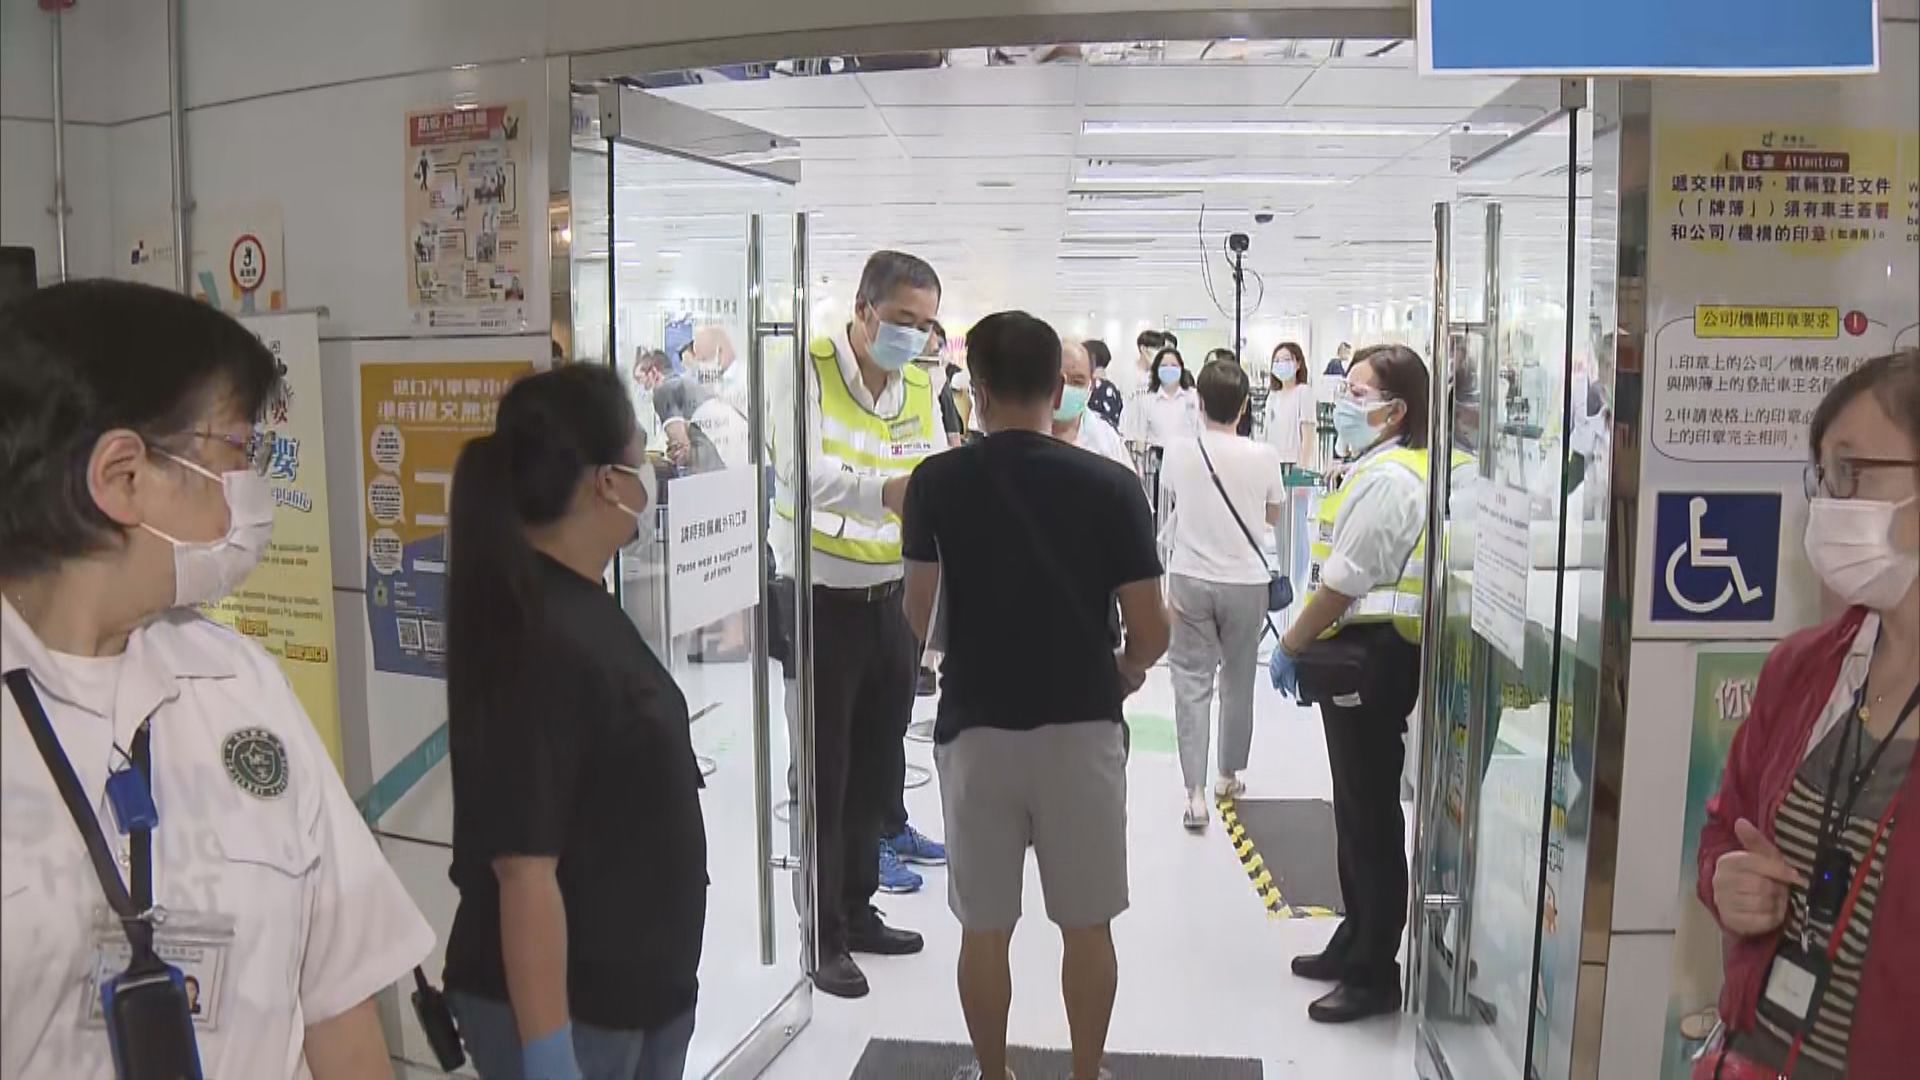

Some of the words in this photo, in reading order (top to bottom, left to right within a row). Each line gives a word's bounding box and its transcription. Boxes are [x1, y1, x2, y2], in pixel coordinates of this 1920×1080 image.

[1746, 154, 1775, 168] 注意
[1784, 154, 1843, 168] Attention
[1703, 310, 1830, 329] 公司/機構印章要求
